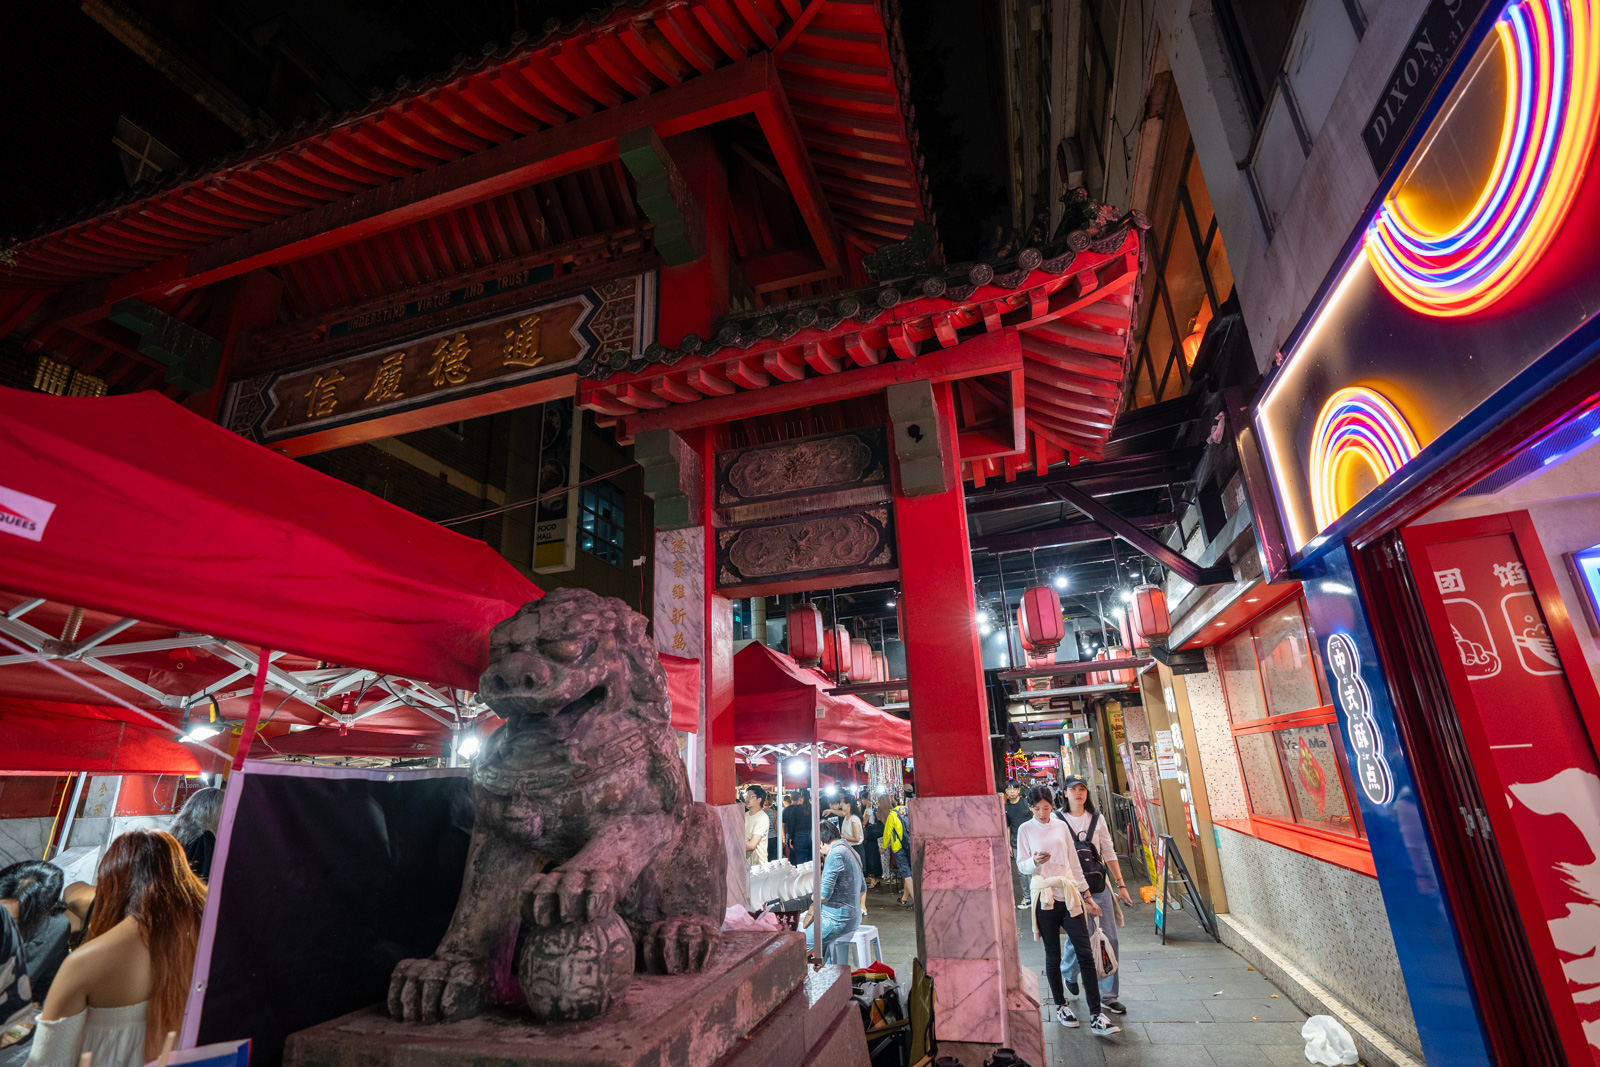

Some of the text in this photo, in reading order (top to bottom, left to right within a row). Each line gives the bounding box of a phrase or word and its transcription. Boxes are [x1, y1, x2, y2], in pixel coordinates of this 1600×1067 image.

[1372, 27, 1437, 146] DIXON
[347, 270, 530, 331] UNDERSTAND VIRTUE AND TRUST
[537, 523, 557, 532] FOOD
[537, 531, 552, 541] HALL
